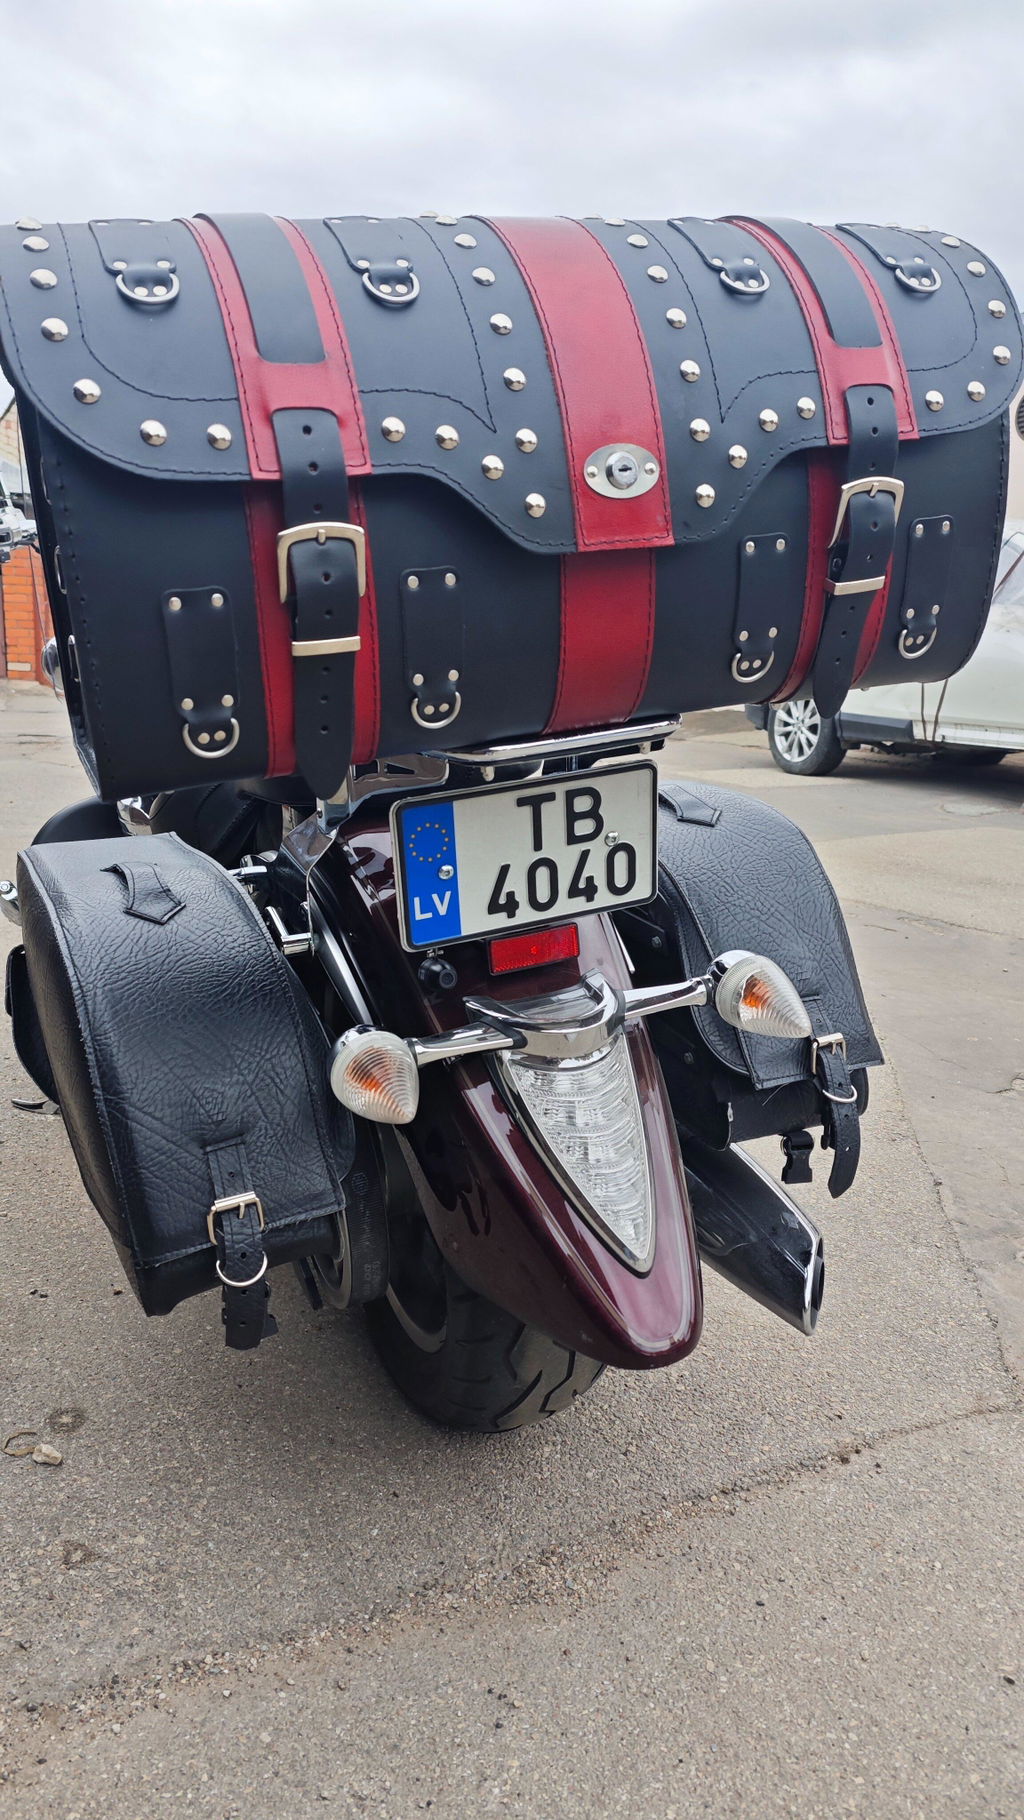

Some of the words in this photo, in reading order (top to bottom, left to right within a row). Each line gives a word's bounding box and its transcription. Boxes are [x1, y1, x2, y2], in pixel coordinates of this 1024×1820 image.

[516, 786, 604, 852] TB
[413, 891, 452, 921] LV
[487, 841, 637, 919] 4040
